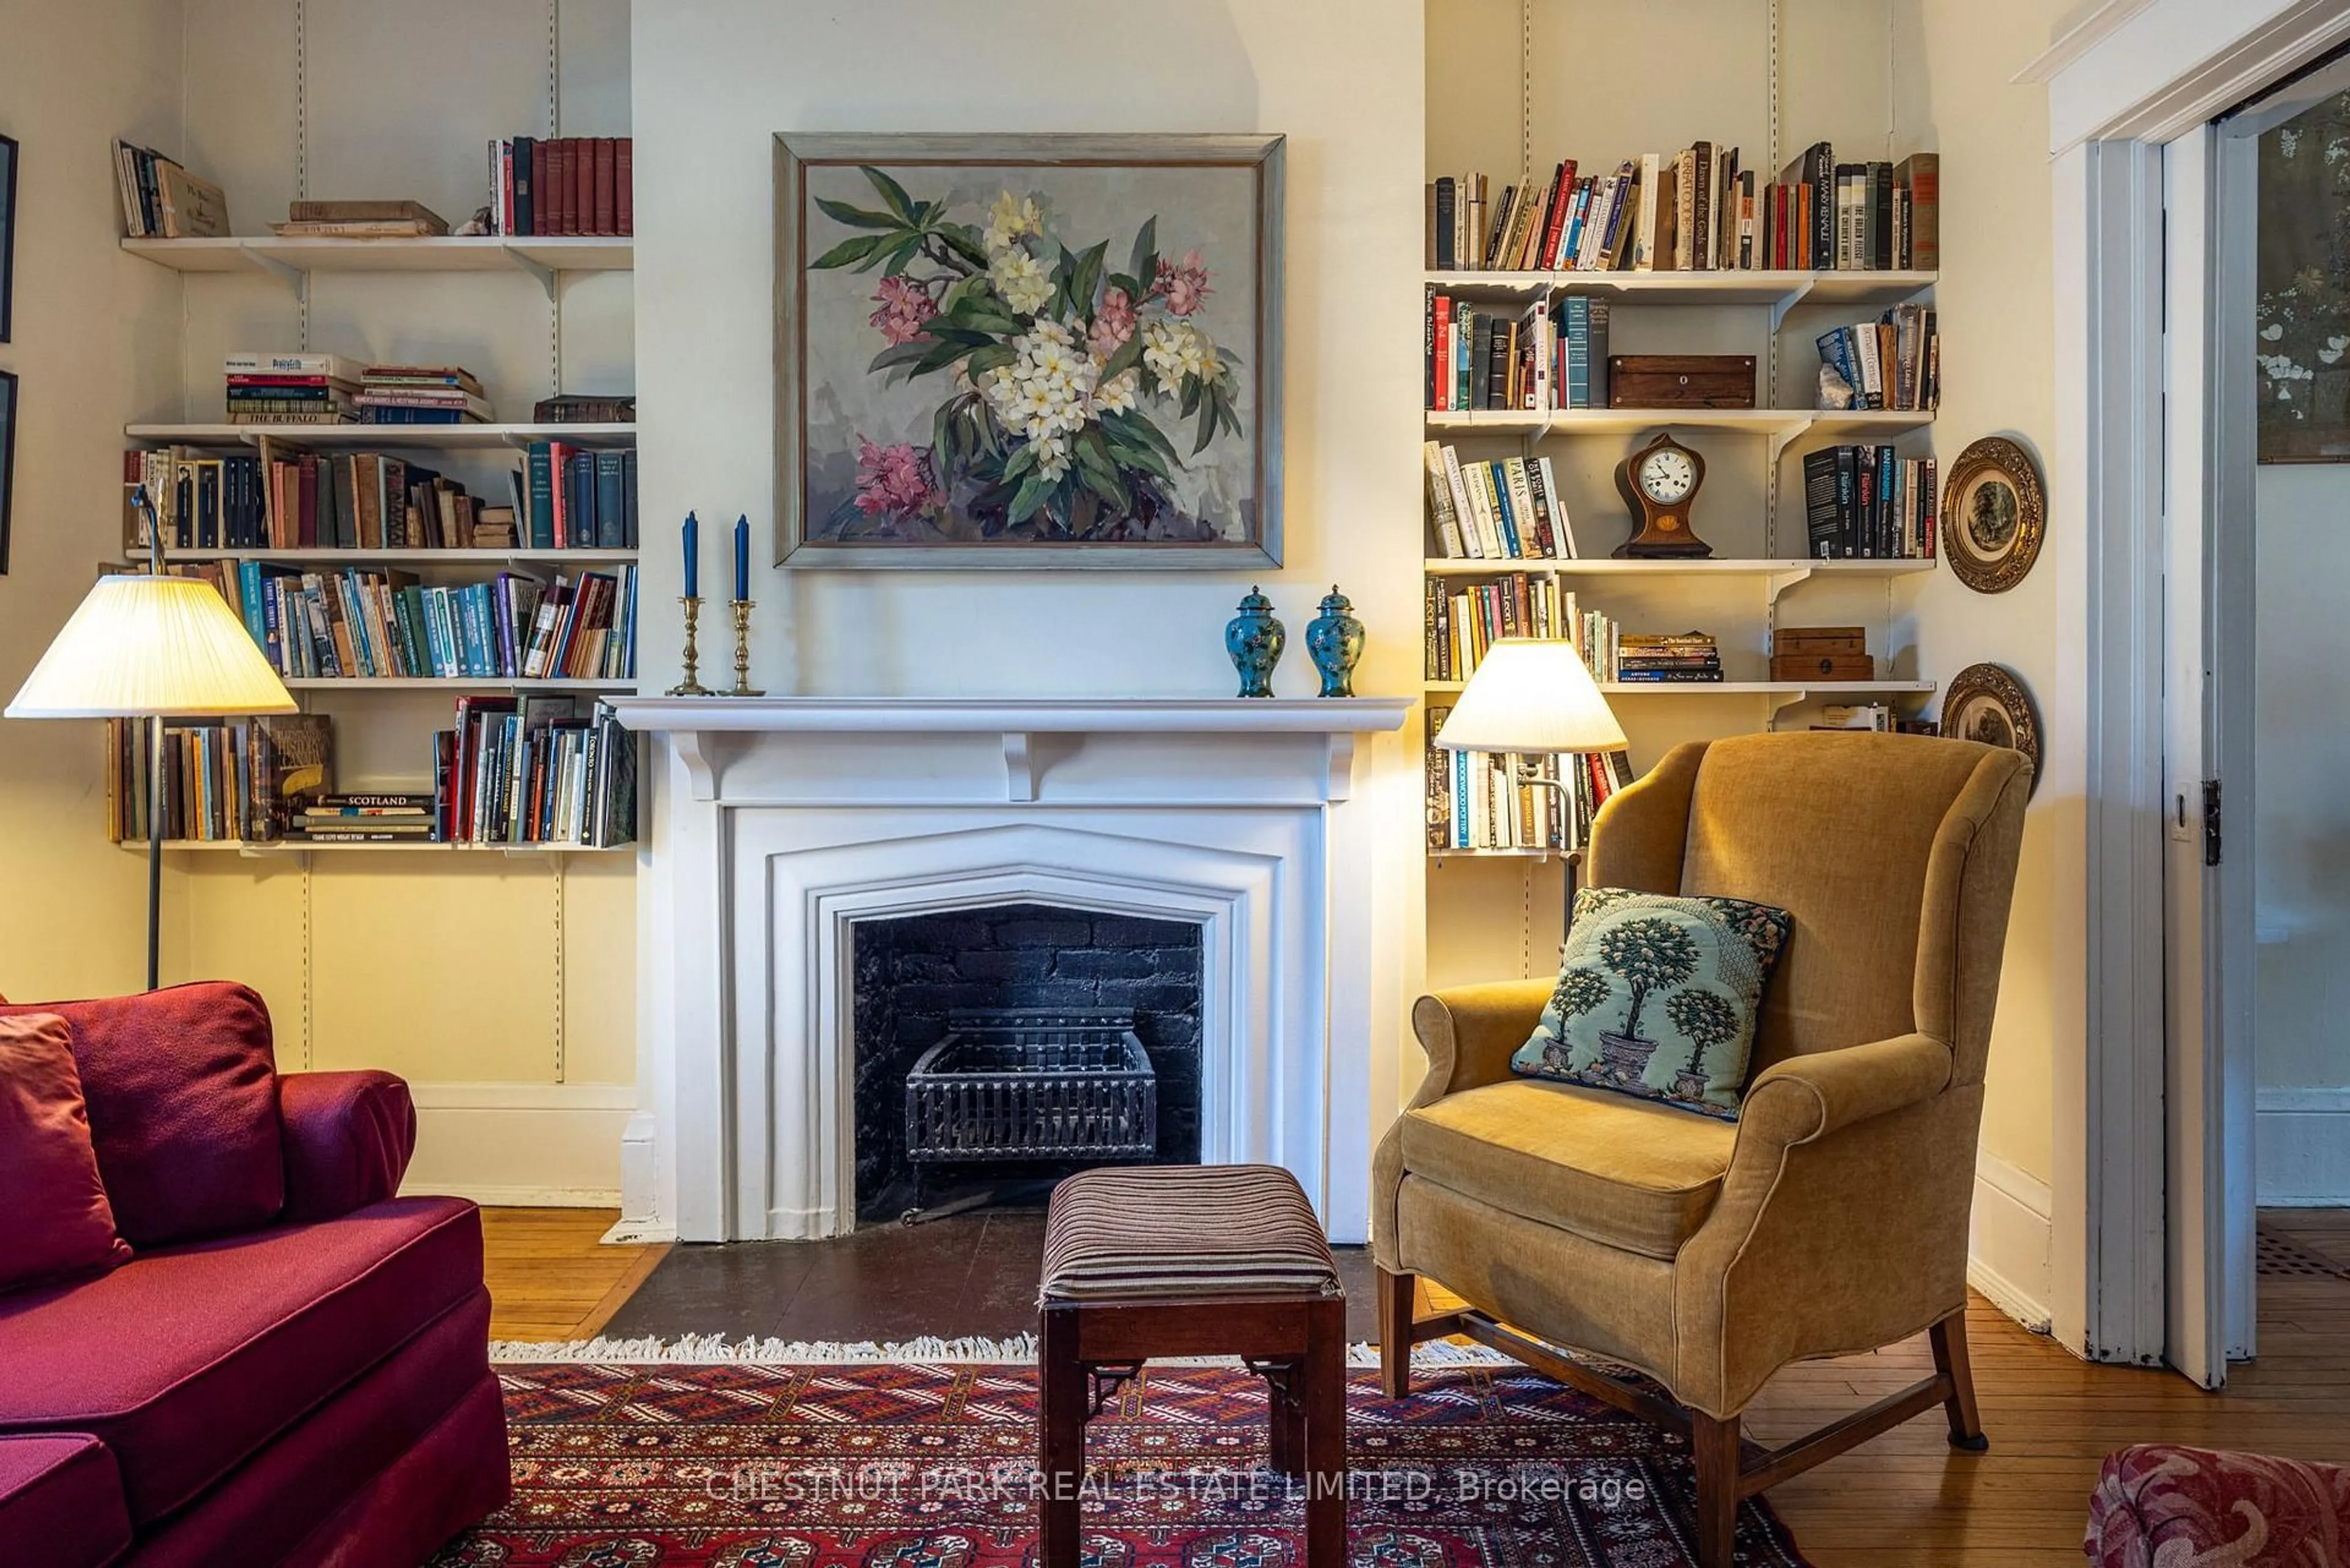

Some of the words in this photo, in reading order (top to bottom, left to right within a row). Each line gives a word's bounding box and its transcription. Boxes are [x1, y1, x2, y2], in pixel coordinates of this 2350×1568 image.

[1682, 155, 1694, 190] GREAT
[1698, 160, 1708, 188] Dawn
[1698, 190, 1708, 200] of
[1821, 179, 1829, 205] MARY
[1697, 203, 1707, 218] the
[1696, 220, 1707, 245] Gods
[1509, 460, 1527, 497] PARIS
[1840, 471, 1849, 504] Rankin
[1861, 472, 1870, 506] Rankin
[1881, 463, 1890, 501] RANKIN
[1426, 597, 1435, 627] Leon
[1503, 595, 1513, 622] Leon
[587, 734, 596, 767] TORONTO
